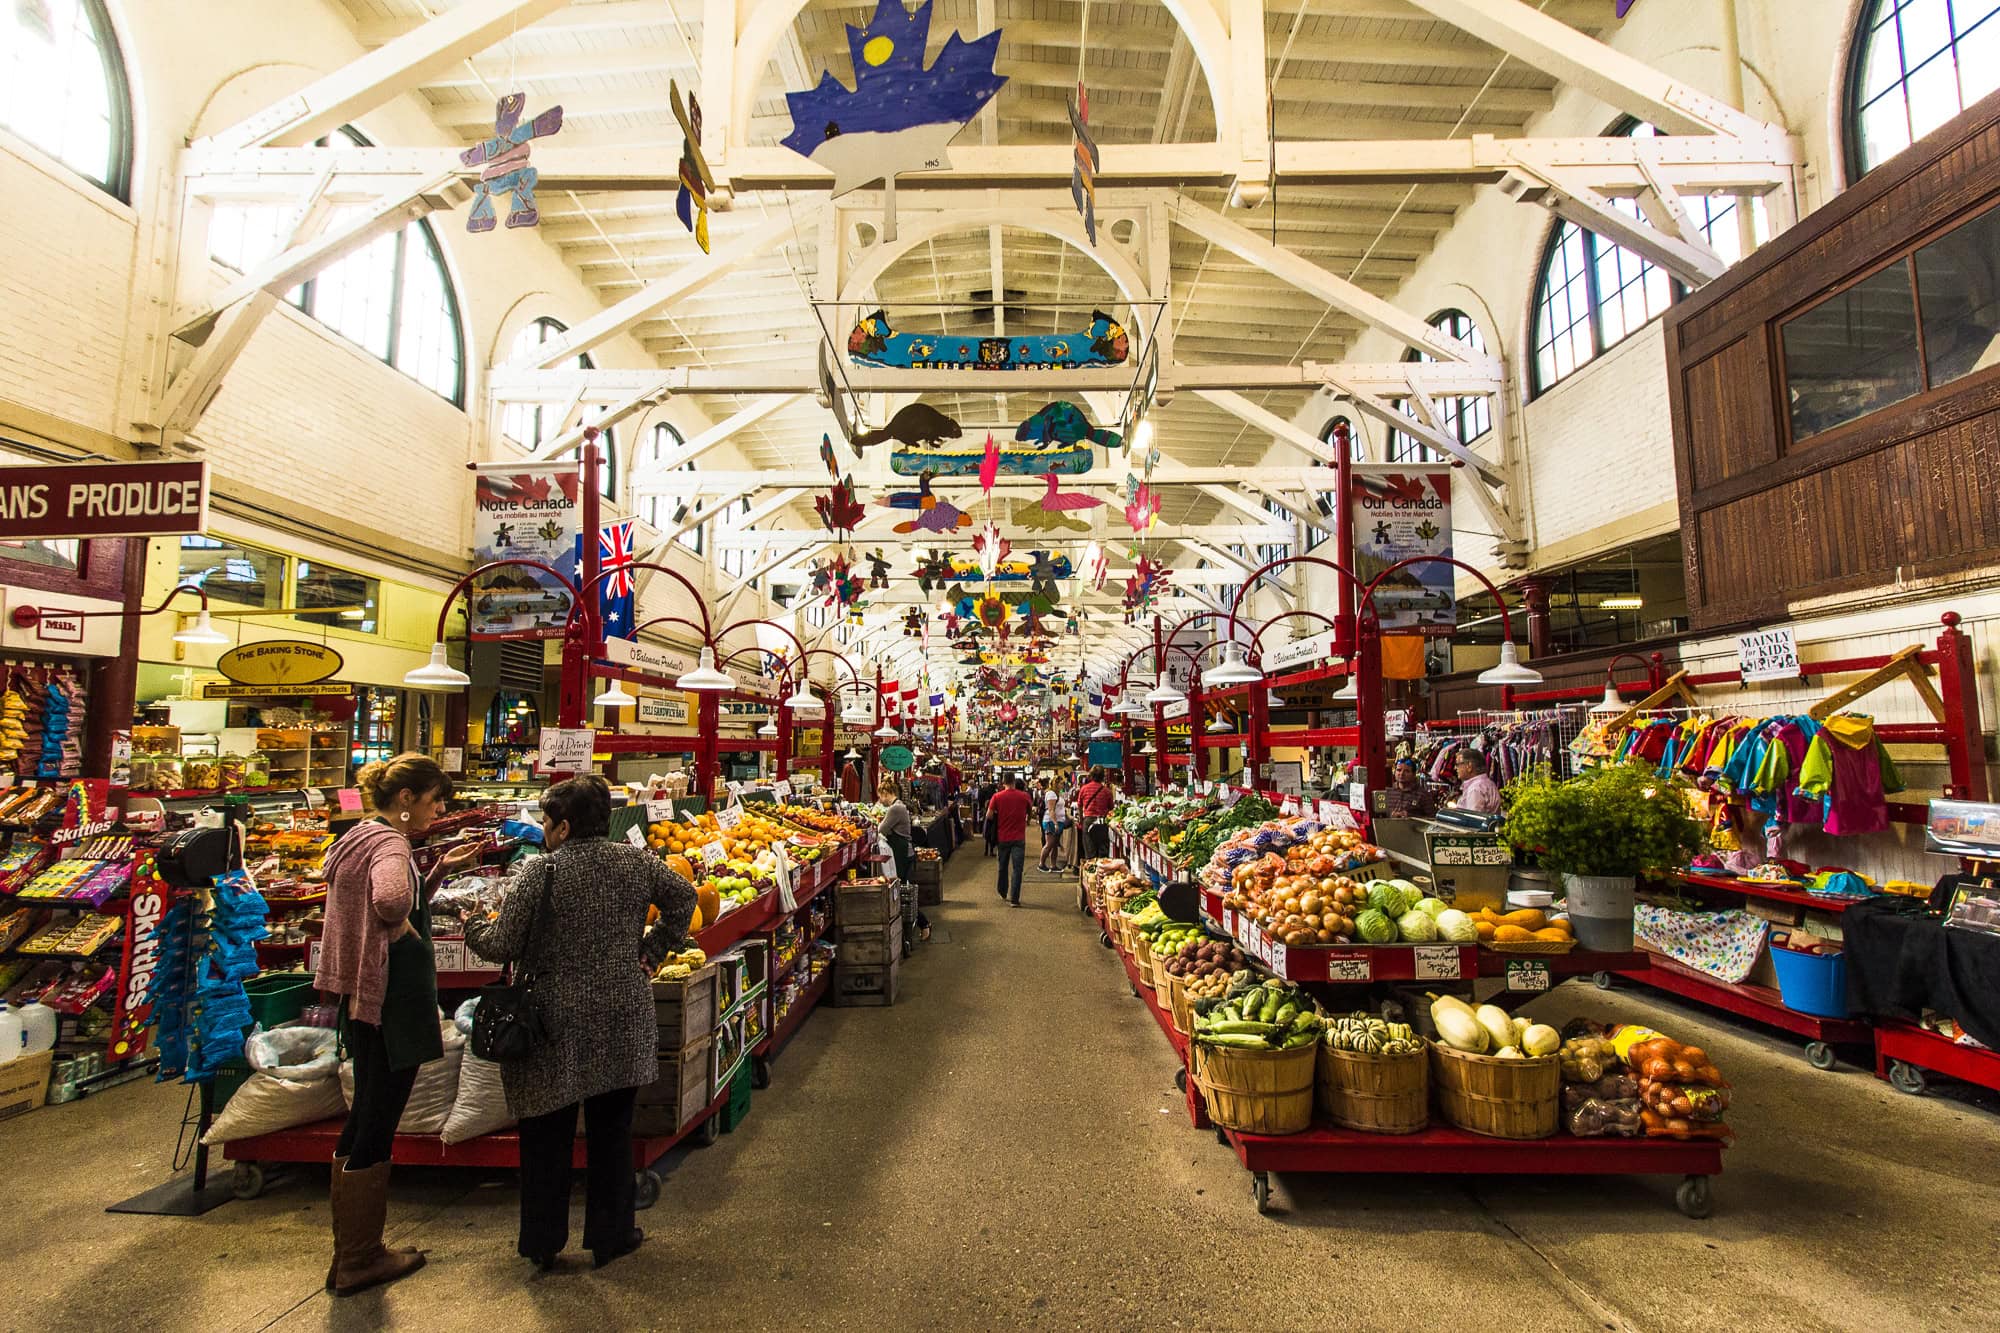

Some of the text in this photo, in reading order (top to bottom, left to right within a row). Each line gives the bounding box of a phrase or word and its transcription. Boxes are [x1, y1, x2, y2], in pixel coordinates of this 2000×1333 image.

[67, 480, 200, 518] PRODUCE
[479, 496, 574, 512] Notre Canada
[1362, 496, 1443, 510] Our Canada
[504, 511, 528, 519] mobiles
[45, 620, 76, 631] Milk
[1741, 631, 1790, 648] MAINLY
[1745, 643, 1790, 658] for KIDS
[292, 687, 319, 695] Specialty
[543, 737, 592, 751] Cold Drinks
[51, 820, 111, 844] Skittles
[125, 894, 162, 1010] Skittles
